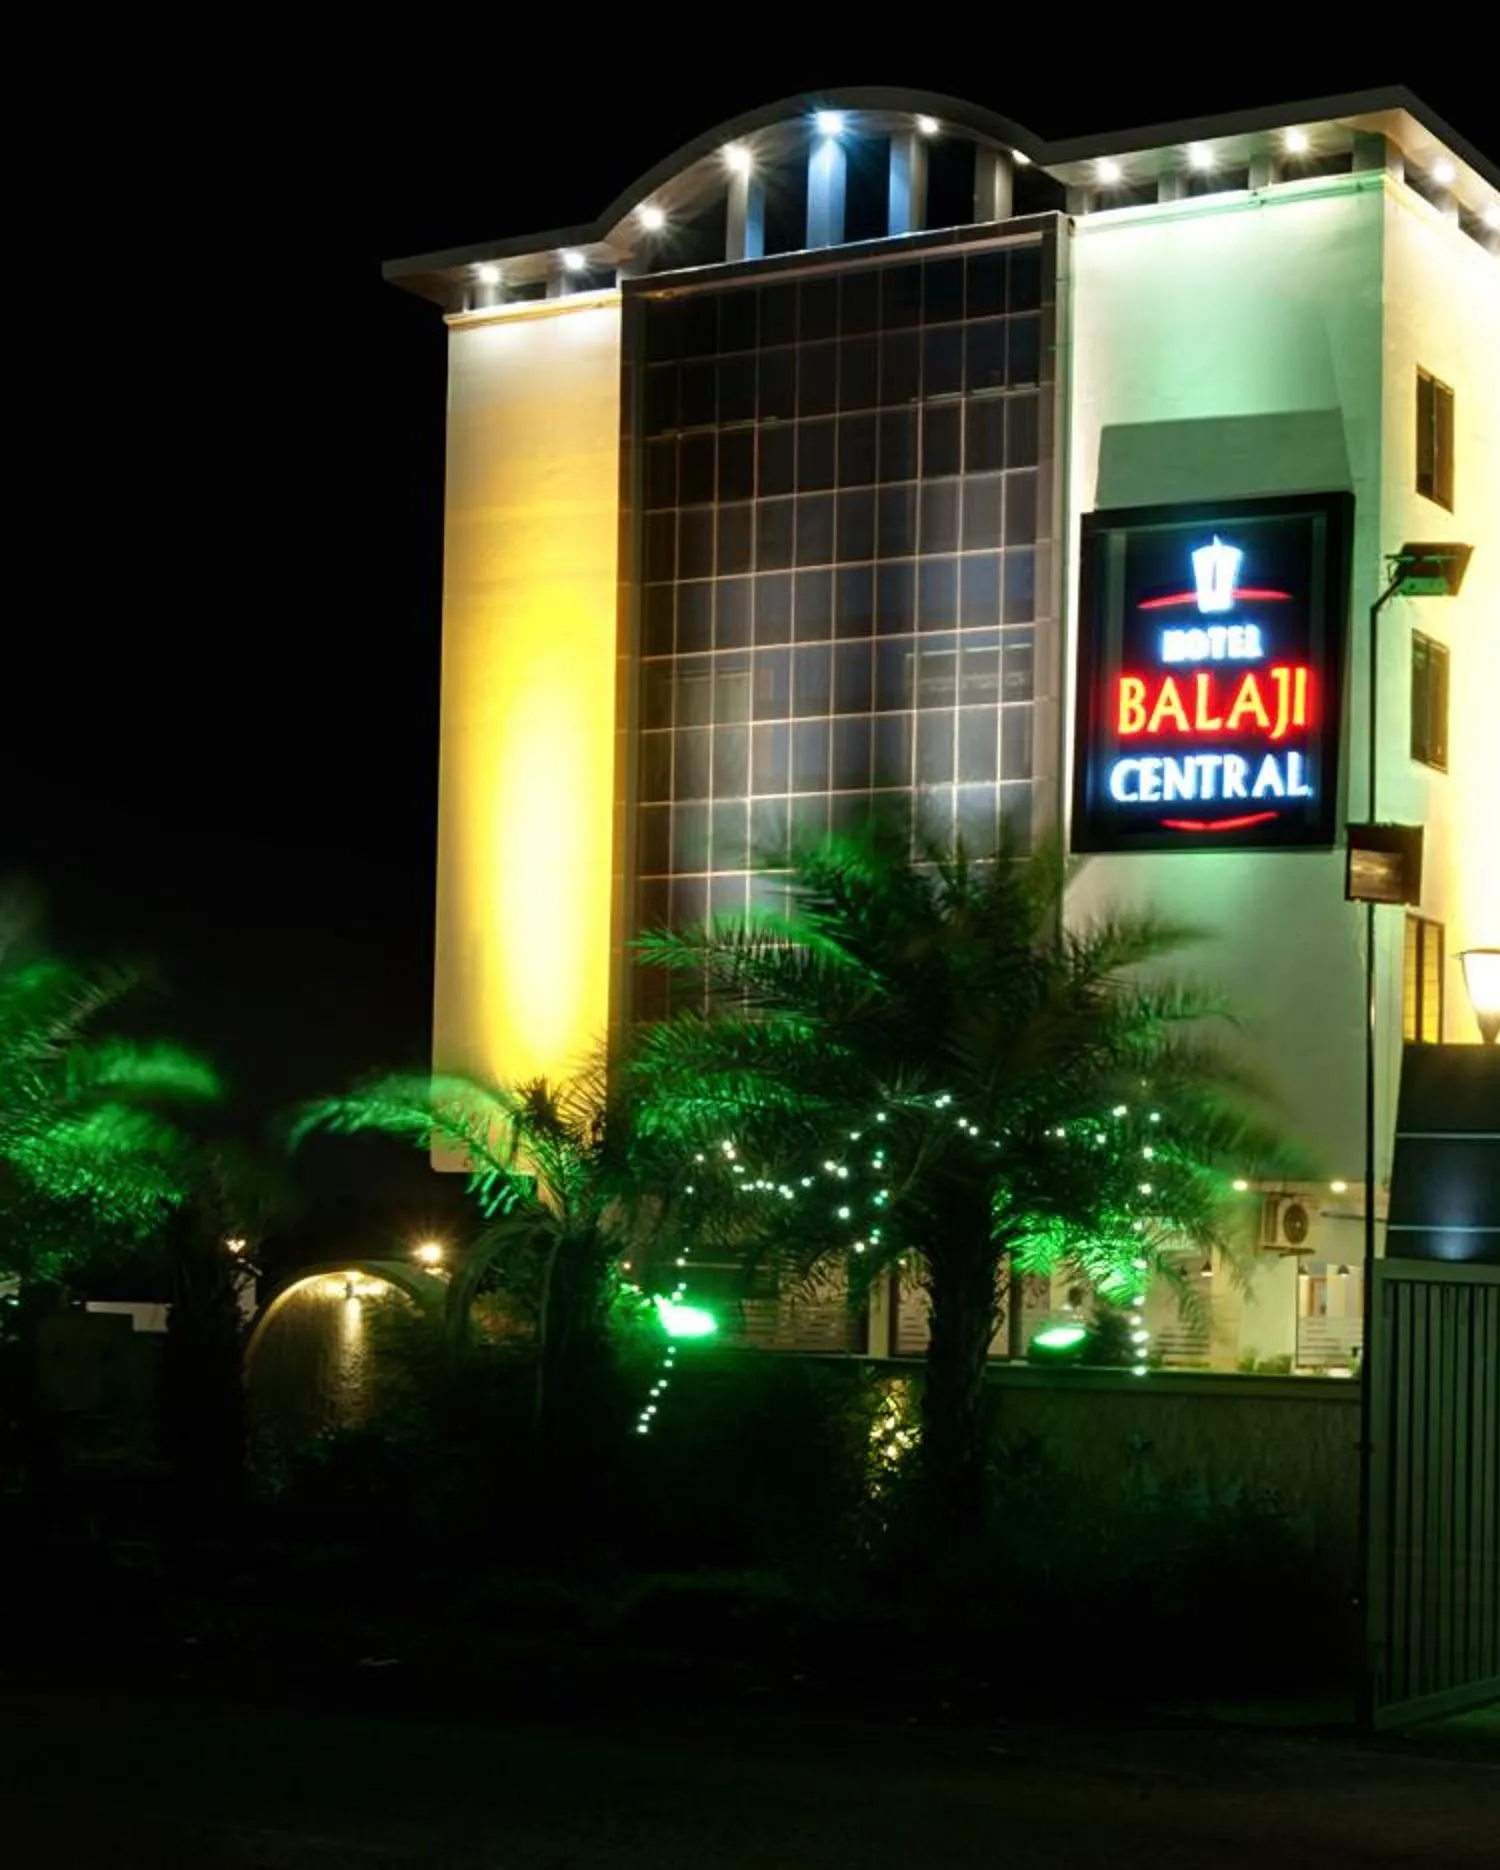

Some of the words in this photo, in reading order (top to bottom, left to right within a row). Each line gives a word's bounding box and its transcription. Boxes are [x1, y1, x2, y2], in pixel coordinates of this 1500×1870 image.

[1162, 623, 1263, 663] HOTEL
[1116, 665, 1309, 740] BALAJI
[1109, 751, 1313, 802] CENTRAL
